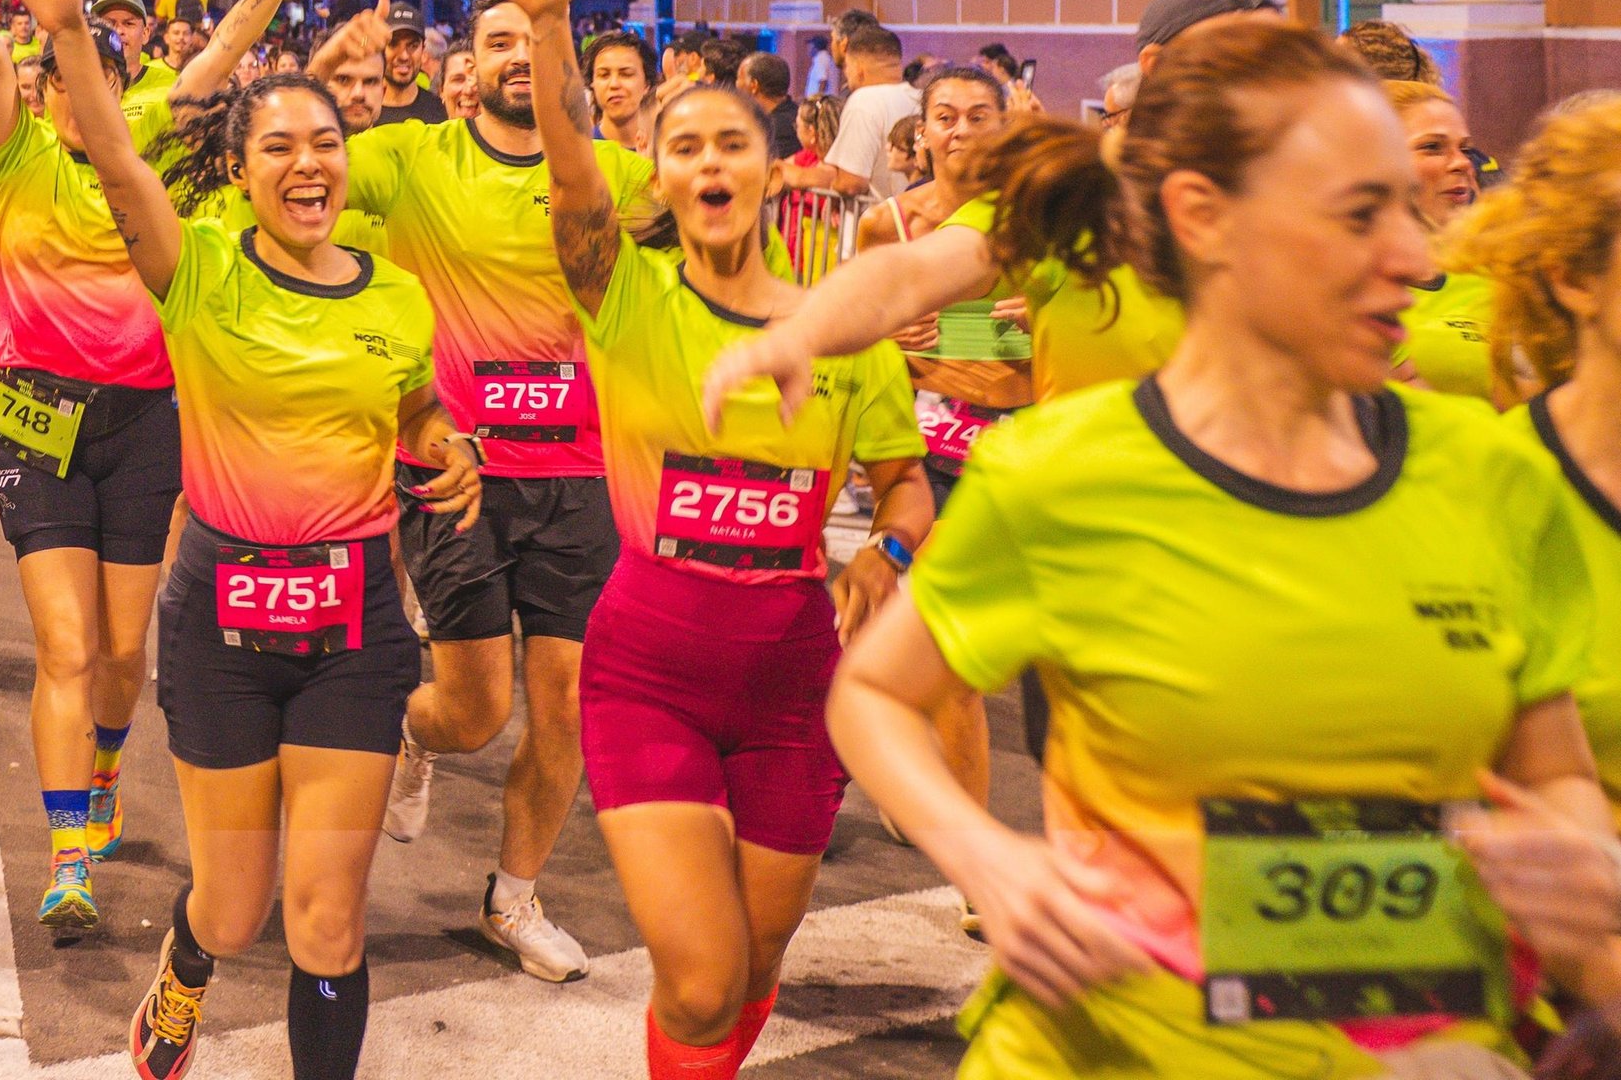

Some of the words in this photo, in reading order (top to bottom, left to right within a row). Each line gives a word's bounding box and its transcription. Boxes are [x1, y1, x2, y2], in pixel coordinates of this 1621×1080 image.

[2, 392, 52, 435] 748
[484, 382, 570, 409] 2757
[670, 480, 800, 527] 2756
[228, 574, 342, 611] 2751
[1256, 862, 1440, 923] 309
